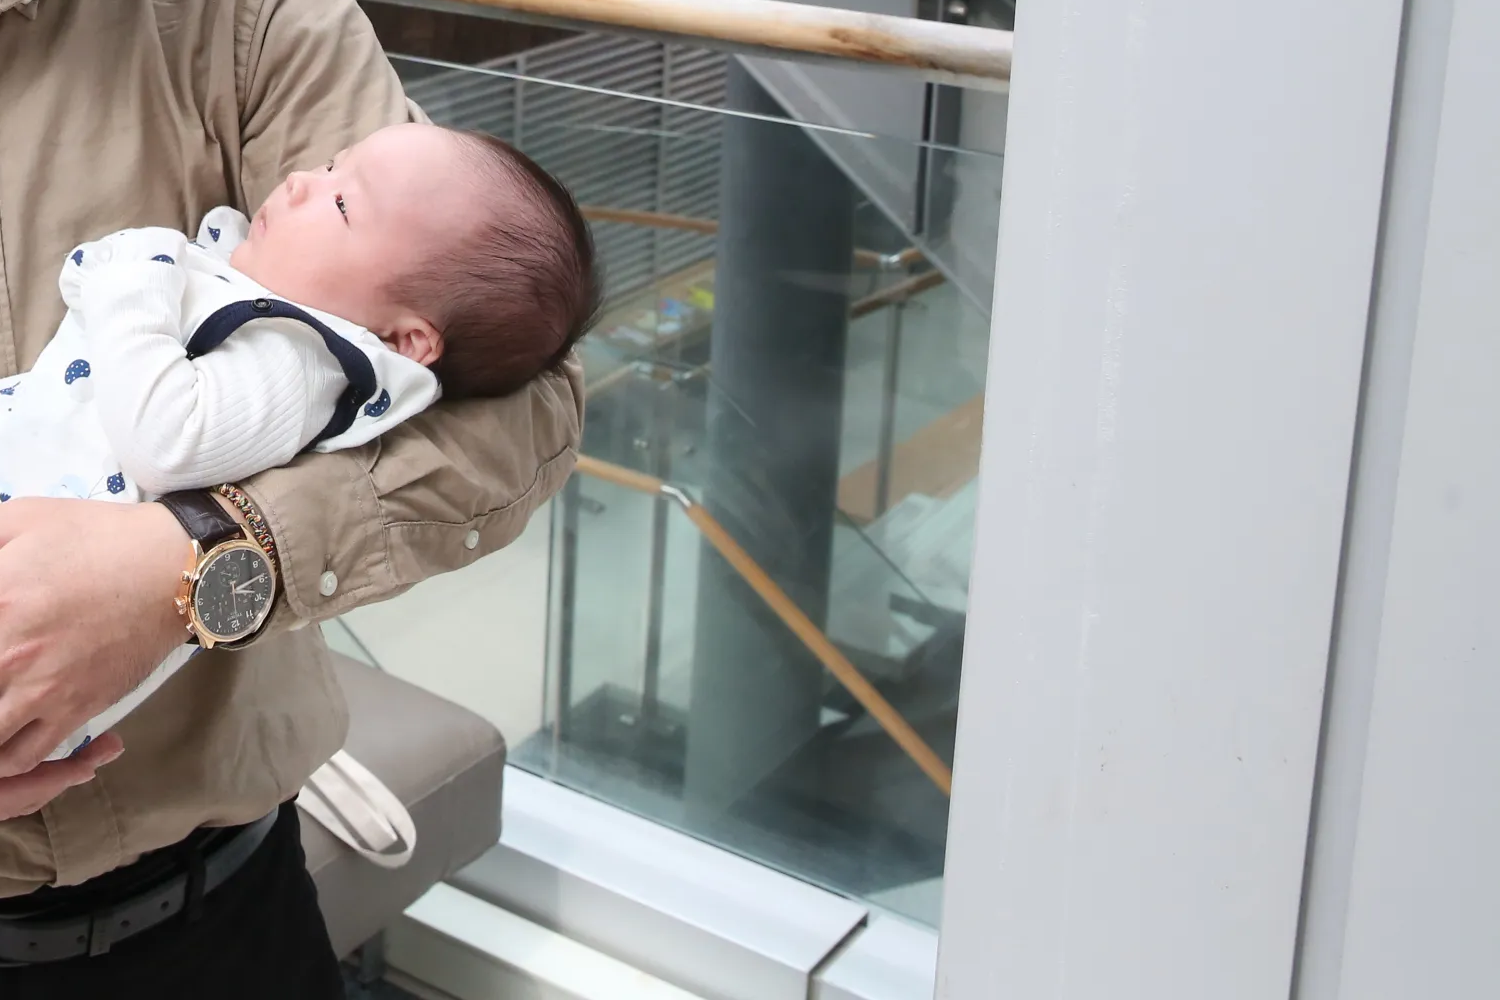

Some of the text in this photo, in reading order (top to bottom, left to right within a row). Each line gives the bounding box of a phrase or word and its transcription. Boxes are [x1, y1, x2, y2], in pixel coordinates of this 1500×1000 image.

[225, 553, 231, 561] 6
[241, 553, 246, 561] 7
[253, 560, 258, 569] 8
[204, 612, 210, 621] 2
[245, 609, 254, 618] 11
[231, 619, 240, 629] 12
